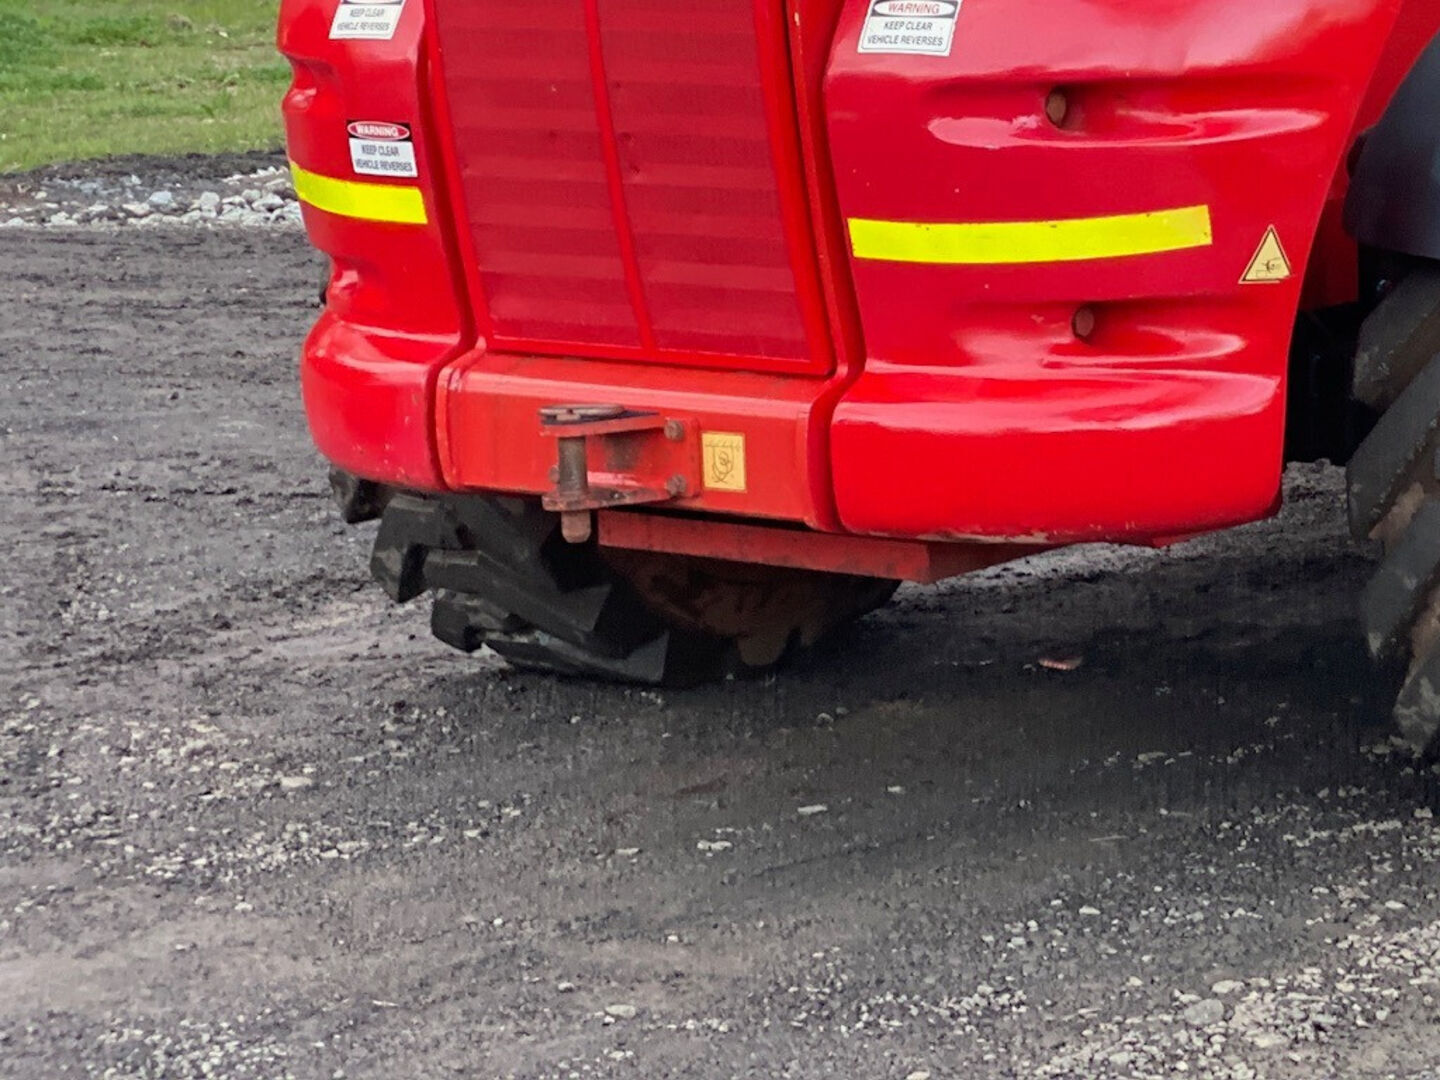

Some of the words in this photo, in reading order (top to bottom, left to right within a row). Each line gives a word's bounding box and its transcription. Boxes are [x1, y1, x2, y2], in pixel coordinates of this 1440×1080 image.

[888, 3, 940, 14] WARNING
[884, 21, 904, 30] KEEP
[905, 21, 933, 31] CLEAR
[867, 34, 899, 45] VEHICLE
[900, 35, 943, 46] REVERSES
[357, 124, 399, 136] WARNING
[361, 144, 377, 155] KEEP
[378, 145, 400, 156] CLEAR
[379, 159, 413, 172] REVERSES
